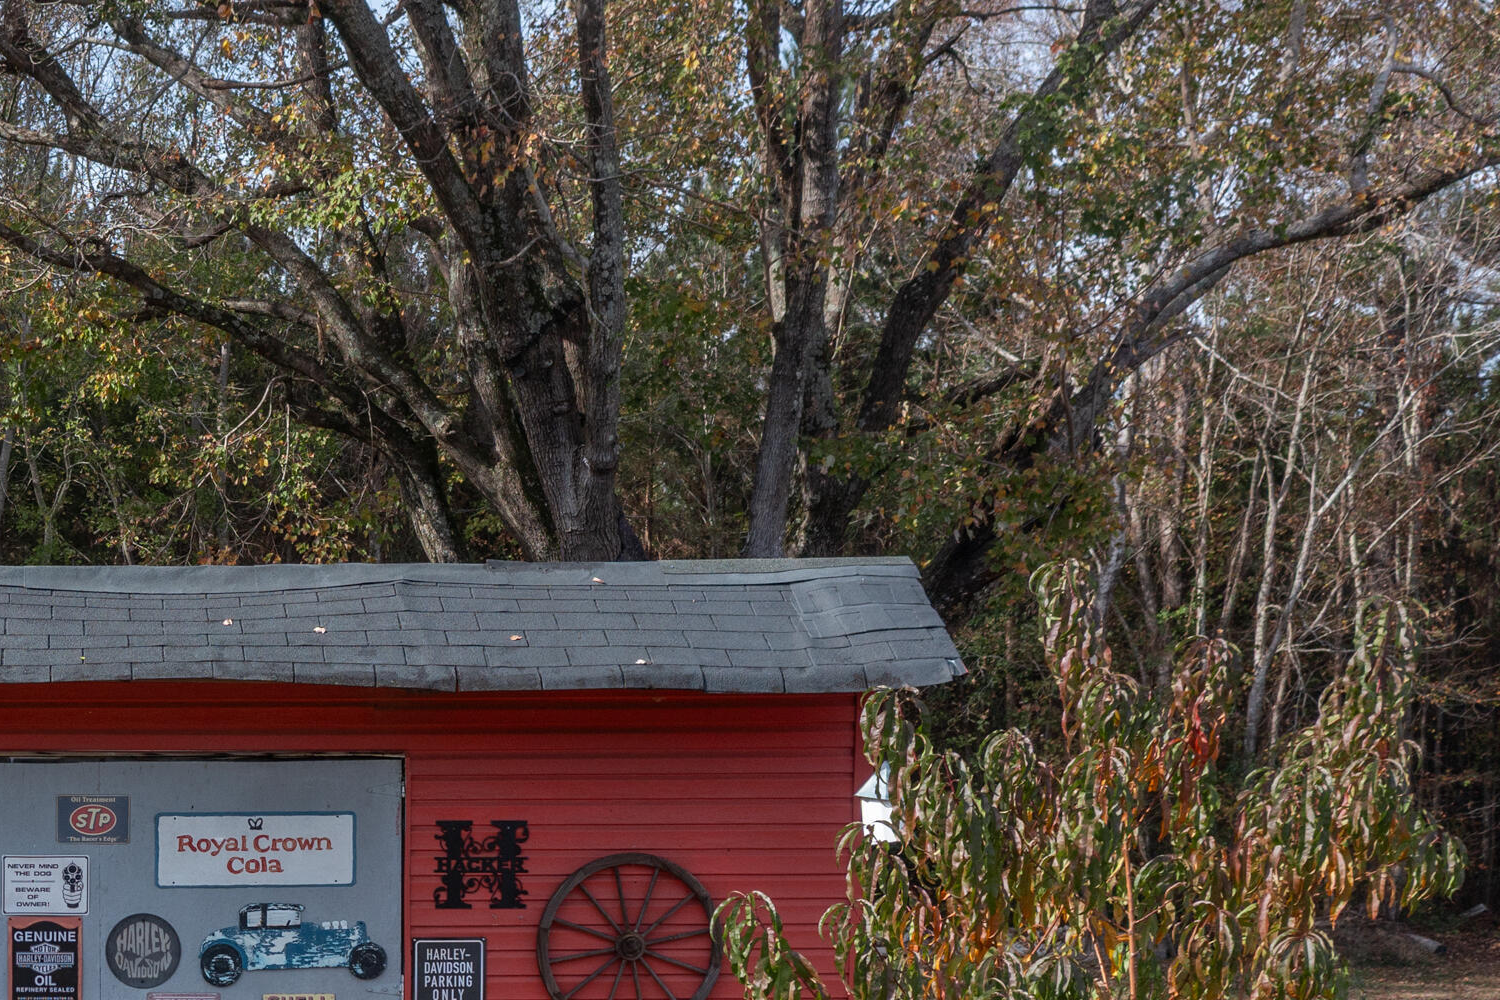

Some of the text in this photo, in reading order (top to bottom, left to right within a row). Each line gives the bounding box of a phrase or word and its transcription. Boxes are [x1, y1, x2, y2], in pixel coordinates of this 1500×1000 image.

[75, 808, 112, 830] STP
[176, 834, 333, 857] Royal Crown
[226, 856, 284, 874] Cola
[434, 856, 528, 873] HACKER
[13, 931, 77, 942] GENUINE
[18, 954, 72, 963] HARLEY-DAVIDSON
[426, 948, 471, 960] HARLEY-
[424, 962, 474, 973] DAVIDSON
[34, 975, 57, 986] OIL
[424, 975, 473, 987] PARKING
[432, 989, 465, 1000] ONLY
